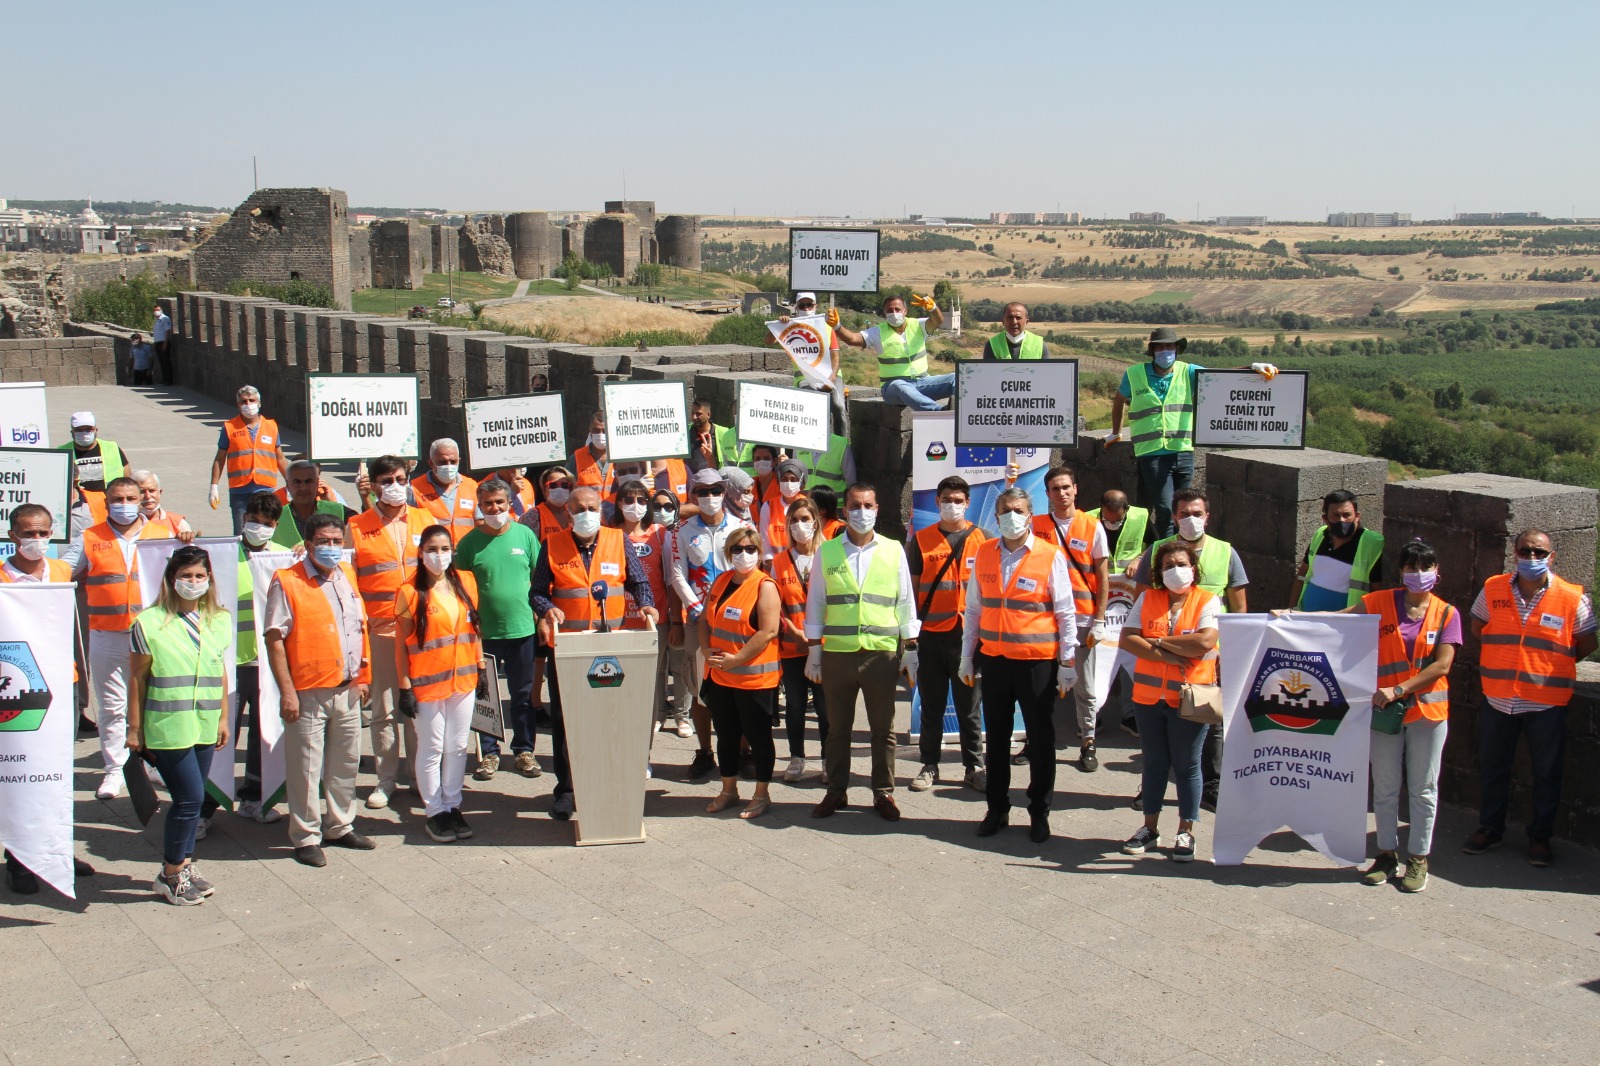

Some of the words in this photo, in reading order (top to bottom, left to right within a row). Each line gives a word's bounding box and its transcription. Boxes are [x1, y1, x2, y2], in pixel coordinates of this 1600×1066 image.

[800, 246, 832, 260] DOĞAL
[835, 249, 870, 261] HAYATI
[820, 264, 849, 276] KORU
[1001, 380, 1032, 393] ÇEVRE
[976, 395, 997, 409] BİZE
[999, 395, 1056, 409] EMANETTİR
[1230, 388, 1271, 402] ÇEVRENİ
[321, 398, 363, 416] DOĞAL
[366, 401, 408, 416] HAYATI
[618, 410, 628, 420] EN
[630, 406, 640, 420] İYİ
[642, 405, 675, 419] TEMİZLİK
[764, 399, 788, 410] TEMİZ
[791, 402, 804, 412] BİR
[1225, 403, 1254, 416] TEMİZ
[1258, 406, 1275, 416] TUT
[483, 417, 514, 432] TEMİZ
[516, 416, 548, 429] İNSAN
[749, 408, 799, 423] DİYARBAKIR
[800, 415, 818, 426] İÇİN
[968, 411, 1013, 426] GELECEĞE
[1015, 412, 1064, 426] MİRASTIR
[348, 423, 383, 438] KORU
[615, 420, 680, 436] KİRLETMEMEKTİR
[772, 424, 780, 433] EL
[782, 425, 795, 435] ELE
[1210, 418, 1258, 431] SAĞLIĞINI
[1261, 421, 1288, 432] KORU
[12, 428, 40, 444] bilgi
[476, 433, 507, 449] TEMİZ
[510, 429, 557, 447] ÇEVREDİR
[8, 490, 31, 503] TUT
[774, 525, 785, 533] DTS
[1149, 620, 1167, 631] DTS
[1271, 650, 1322, 663] DİYARBAKIR
[1255, 662, 1277, 693] TİCARET
[1292, 661, 1325, 678] SANAYİ
[1323, 676, 1338, 699] ODASI
[1286, 762, 1304, 774] VE
[29, 772, 63, 783] ODASI
[1270, 776, 1310, 789] ODASI
